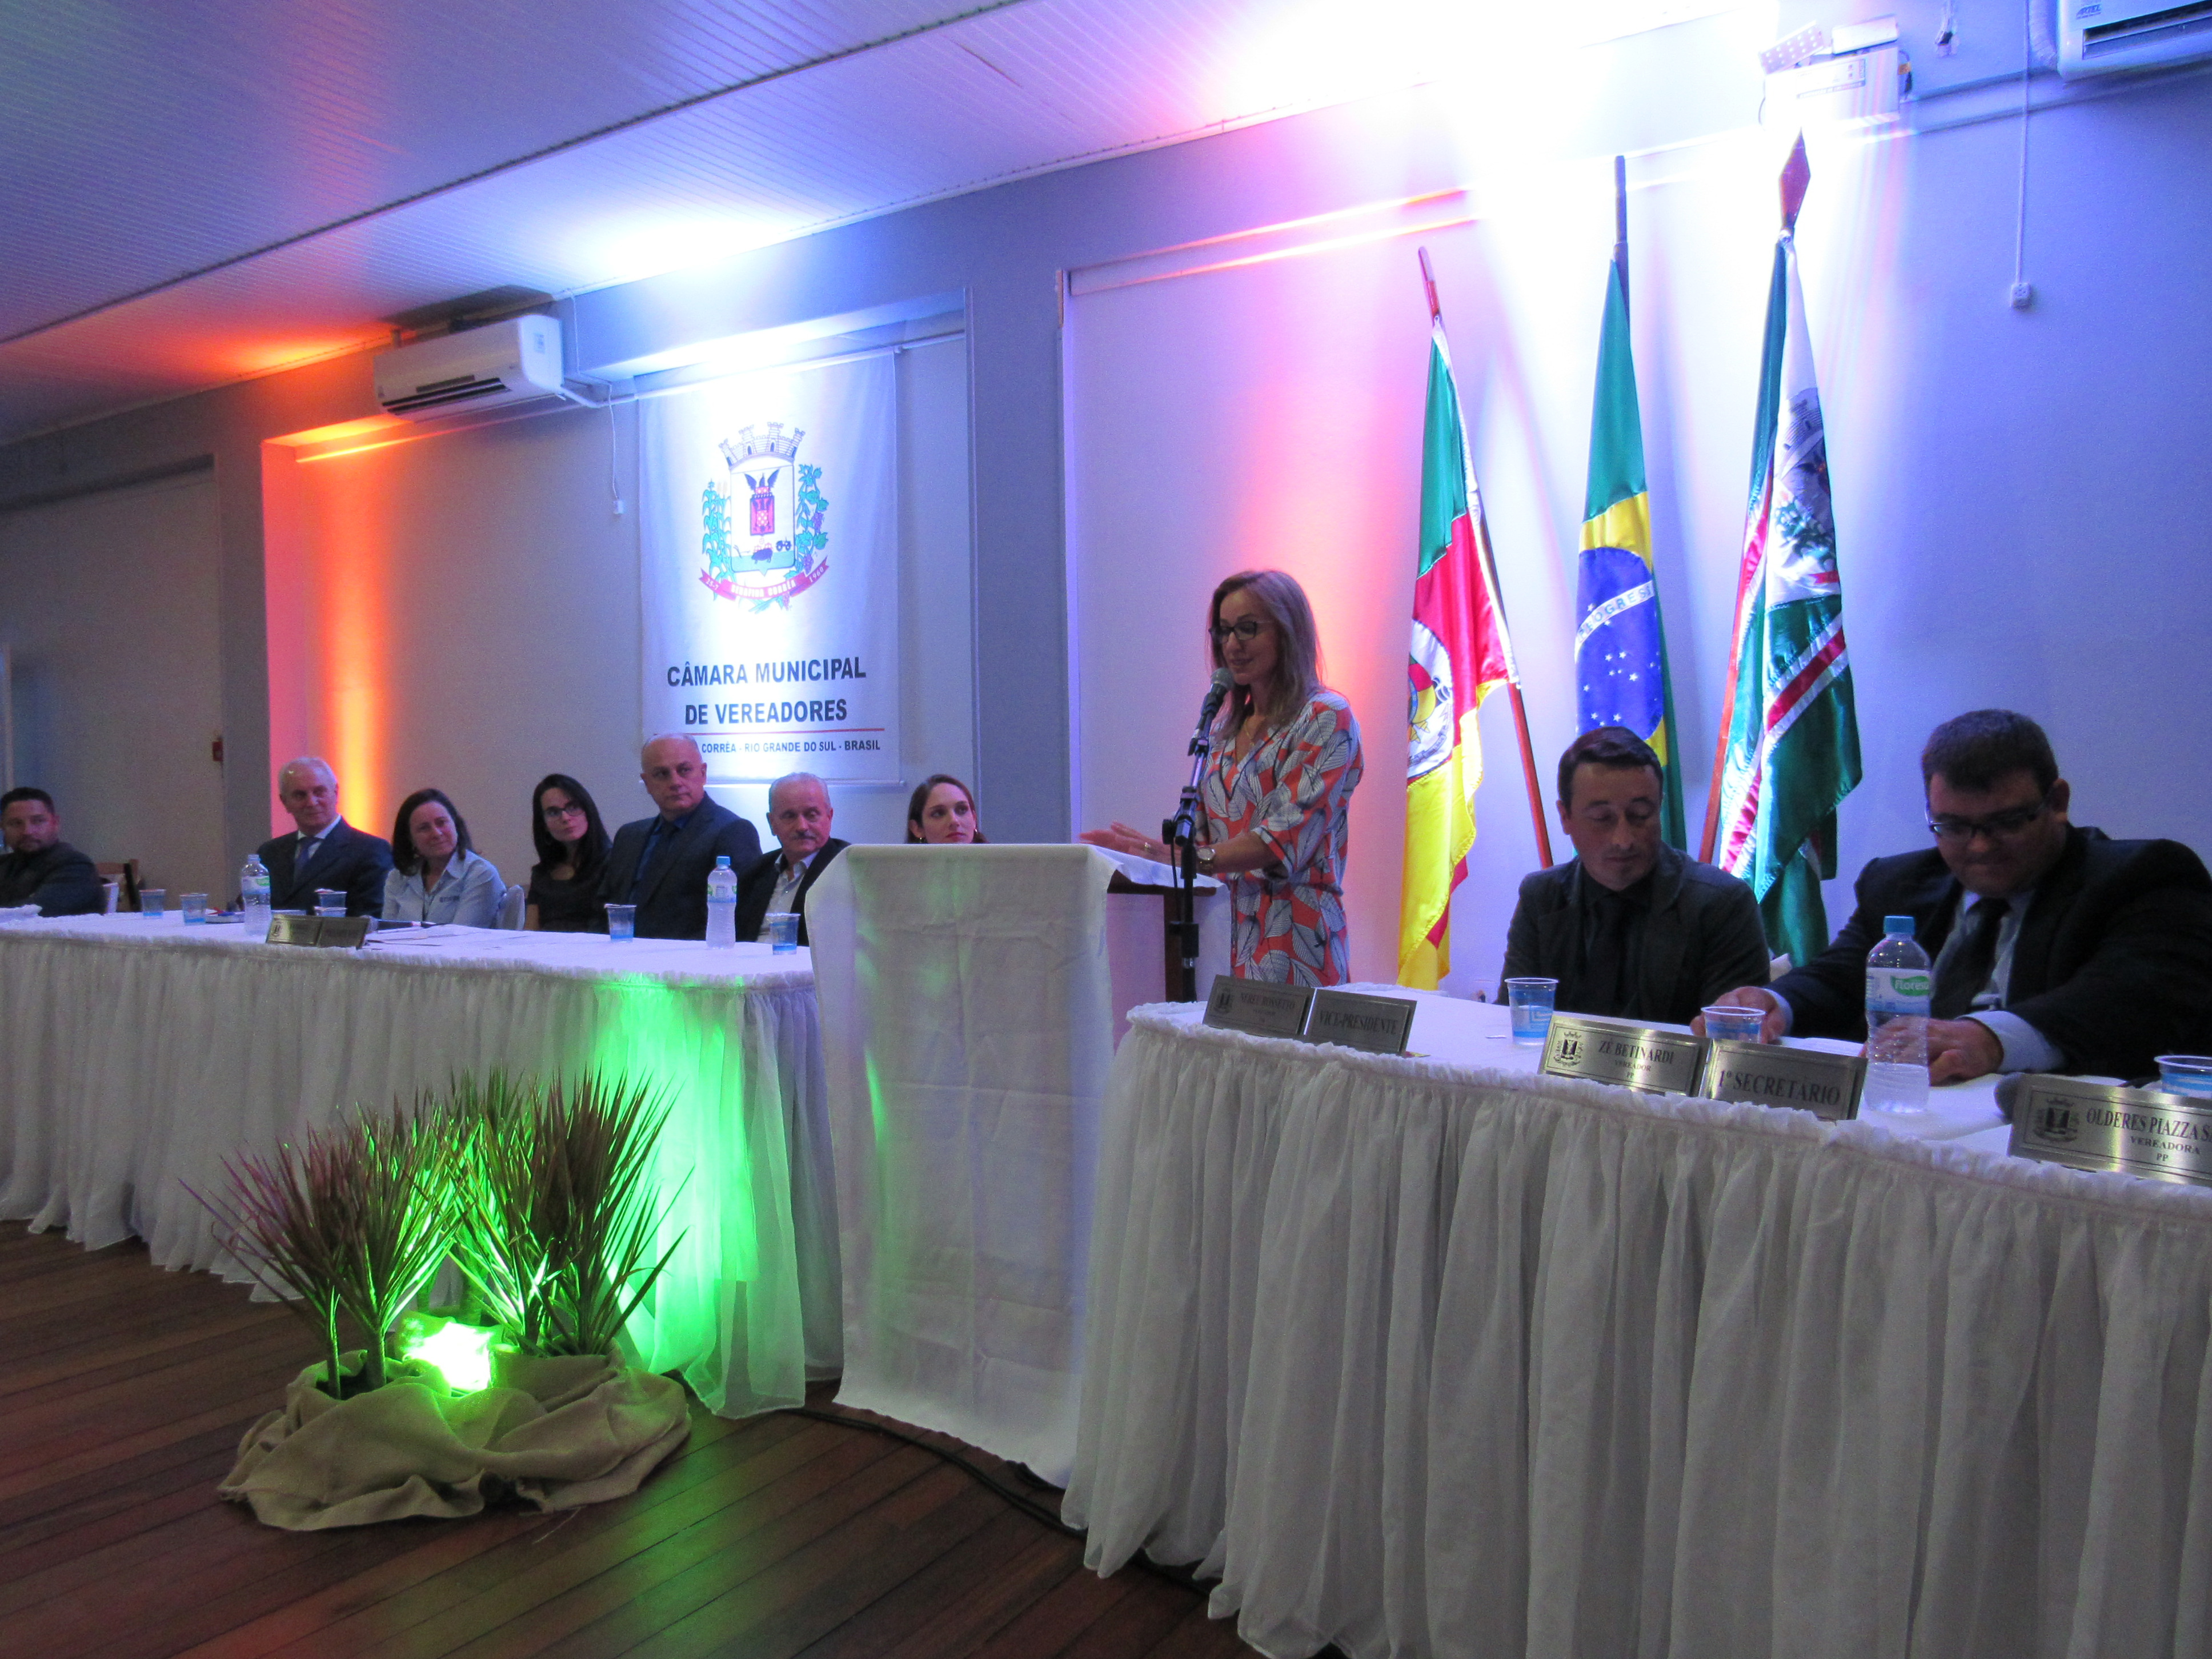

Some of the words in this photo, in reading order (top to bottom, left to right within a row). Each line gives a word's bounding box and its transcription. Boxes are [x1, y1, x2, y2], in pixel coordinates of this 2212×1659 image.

[809, 566, 824, 583] 1960
[667, 661, 748, 687] CÂMARA
[755, 656, 867, 683] MUNICIPAL
[685, 704, 708, 725] DE
[715, 698, 848, 724] VEREADORES
[744, 743, 760, 753] RIO
[763, 742, 801, 753] GRANDE
[804, 742, 817, 752] DO
[819, 740, 837, 751] SUL
[844, 740, 881, 751] BRASIL
[1319, 1009, 1398, 1035] VICE-PRESIDENTE
[1598, 1038, 1613, 1054] ZÉ
[1615, 1043, 1674, 1064] BETINARDI
[1615, 1060, 1652, 1072] VEREADOR
[2086, 1108, 2147, 1132] OLDERES
[2130, 1136, 2201, 1155] VEREADORA
[2157, 1153, 2169, 1161] PP
